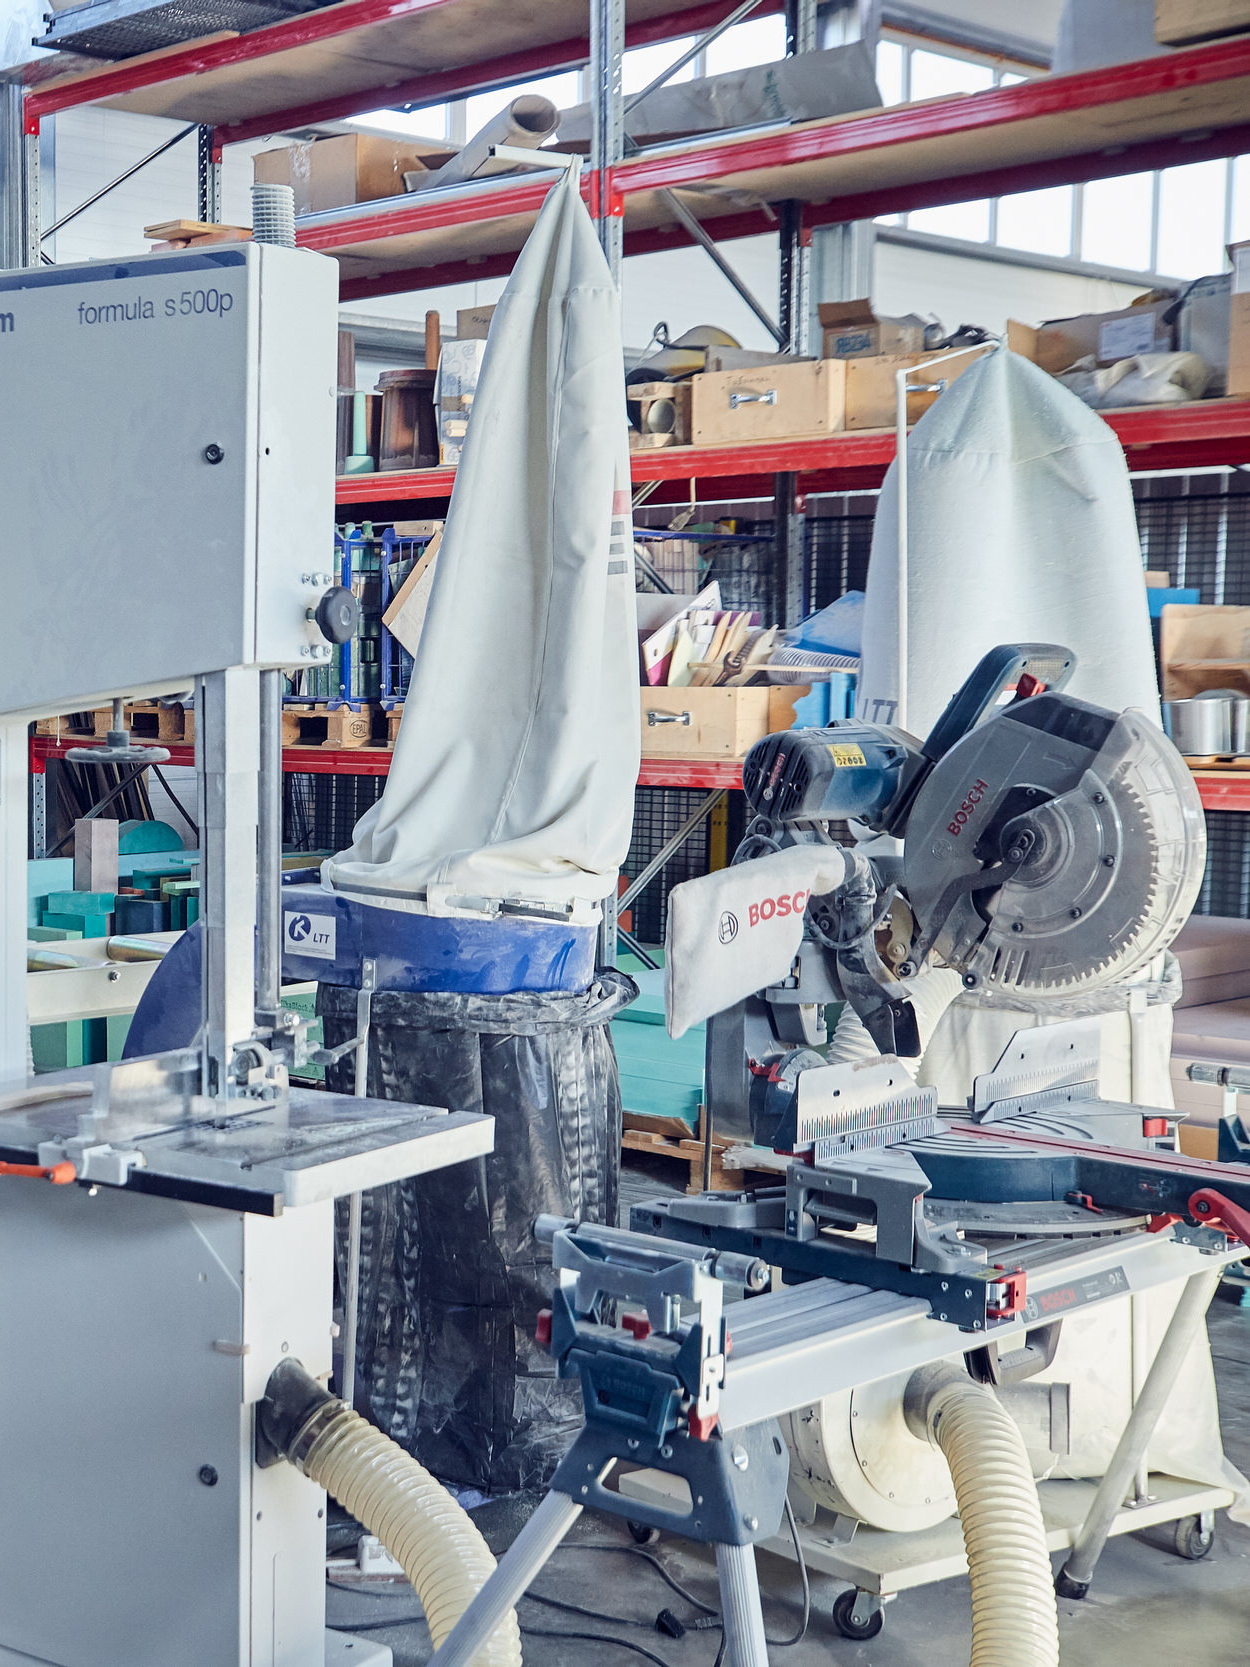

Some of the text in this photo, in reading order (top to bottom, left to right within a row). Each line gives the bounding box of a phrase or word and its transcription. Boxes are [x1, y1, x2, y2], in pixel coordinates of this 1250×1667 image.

[77, 295, 155, 326] formula
[946, 778, 990, 837] BOSCH
[312, 933, 331, 945] LTT
[1039, 1287, 1078, 1312] BOSCH
